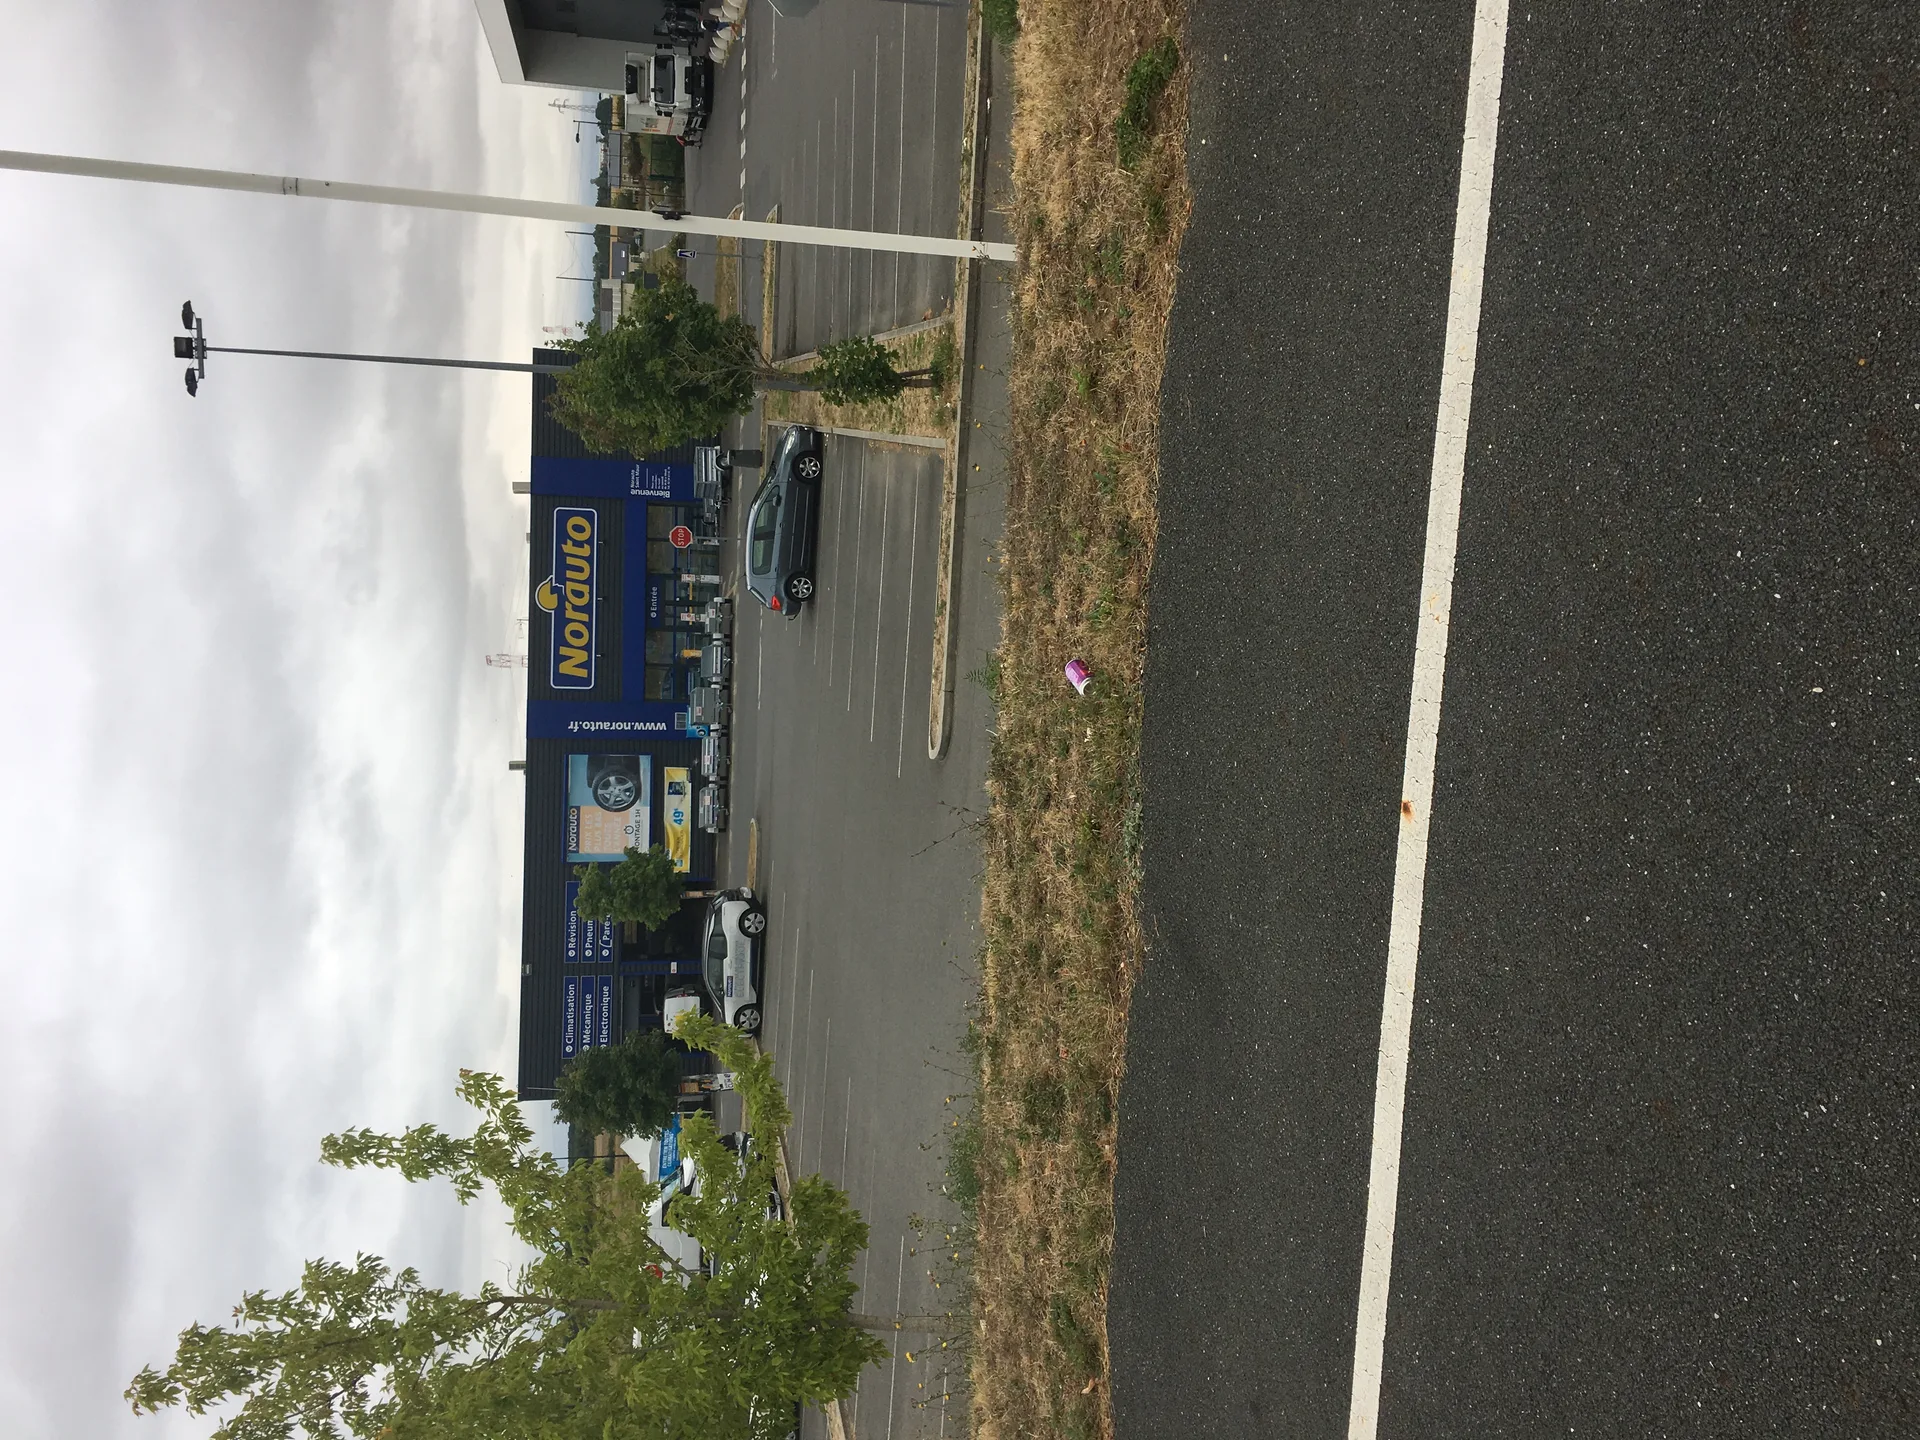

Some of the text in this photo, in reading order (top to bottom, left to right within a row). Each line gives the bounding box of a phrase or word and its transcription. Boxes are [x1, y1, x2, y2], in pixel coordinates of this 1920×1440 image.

[630, 489, 670, 498] Bienvenue
[677, 528, 685, 546] STOP
[559, 516, 591, 678] Norauto
[650, 586, 658, 611] Entrée
[568, 721, 667, 732] www.norauto.fr
[568, 808, 578, 851] Norauto
[634, 809, 641, 818] 1H
[584, 814, 593, 852] PRIX LES
[593, 830, 602, 852] PLUS
[603, 822, 612, 852] TOUTE
[567, 910, 577, 949] Révision
[565, 984, 576, 1044] Climatisation
[582, 994, 593, 1043] Mécanique
[599, 986, 610, 1043] Electronique
